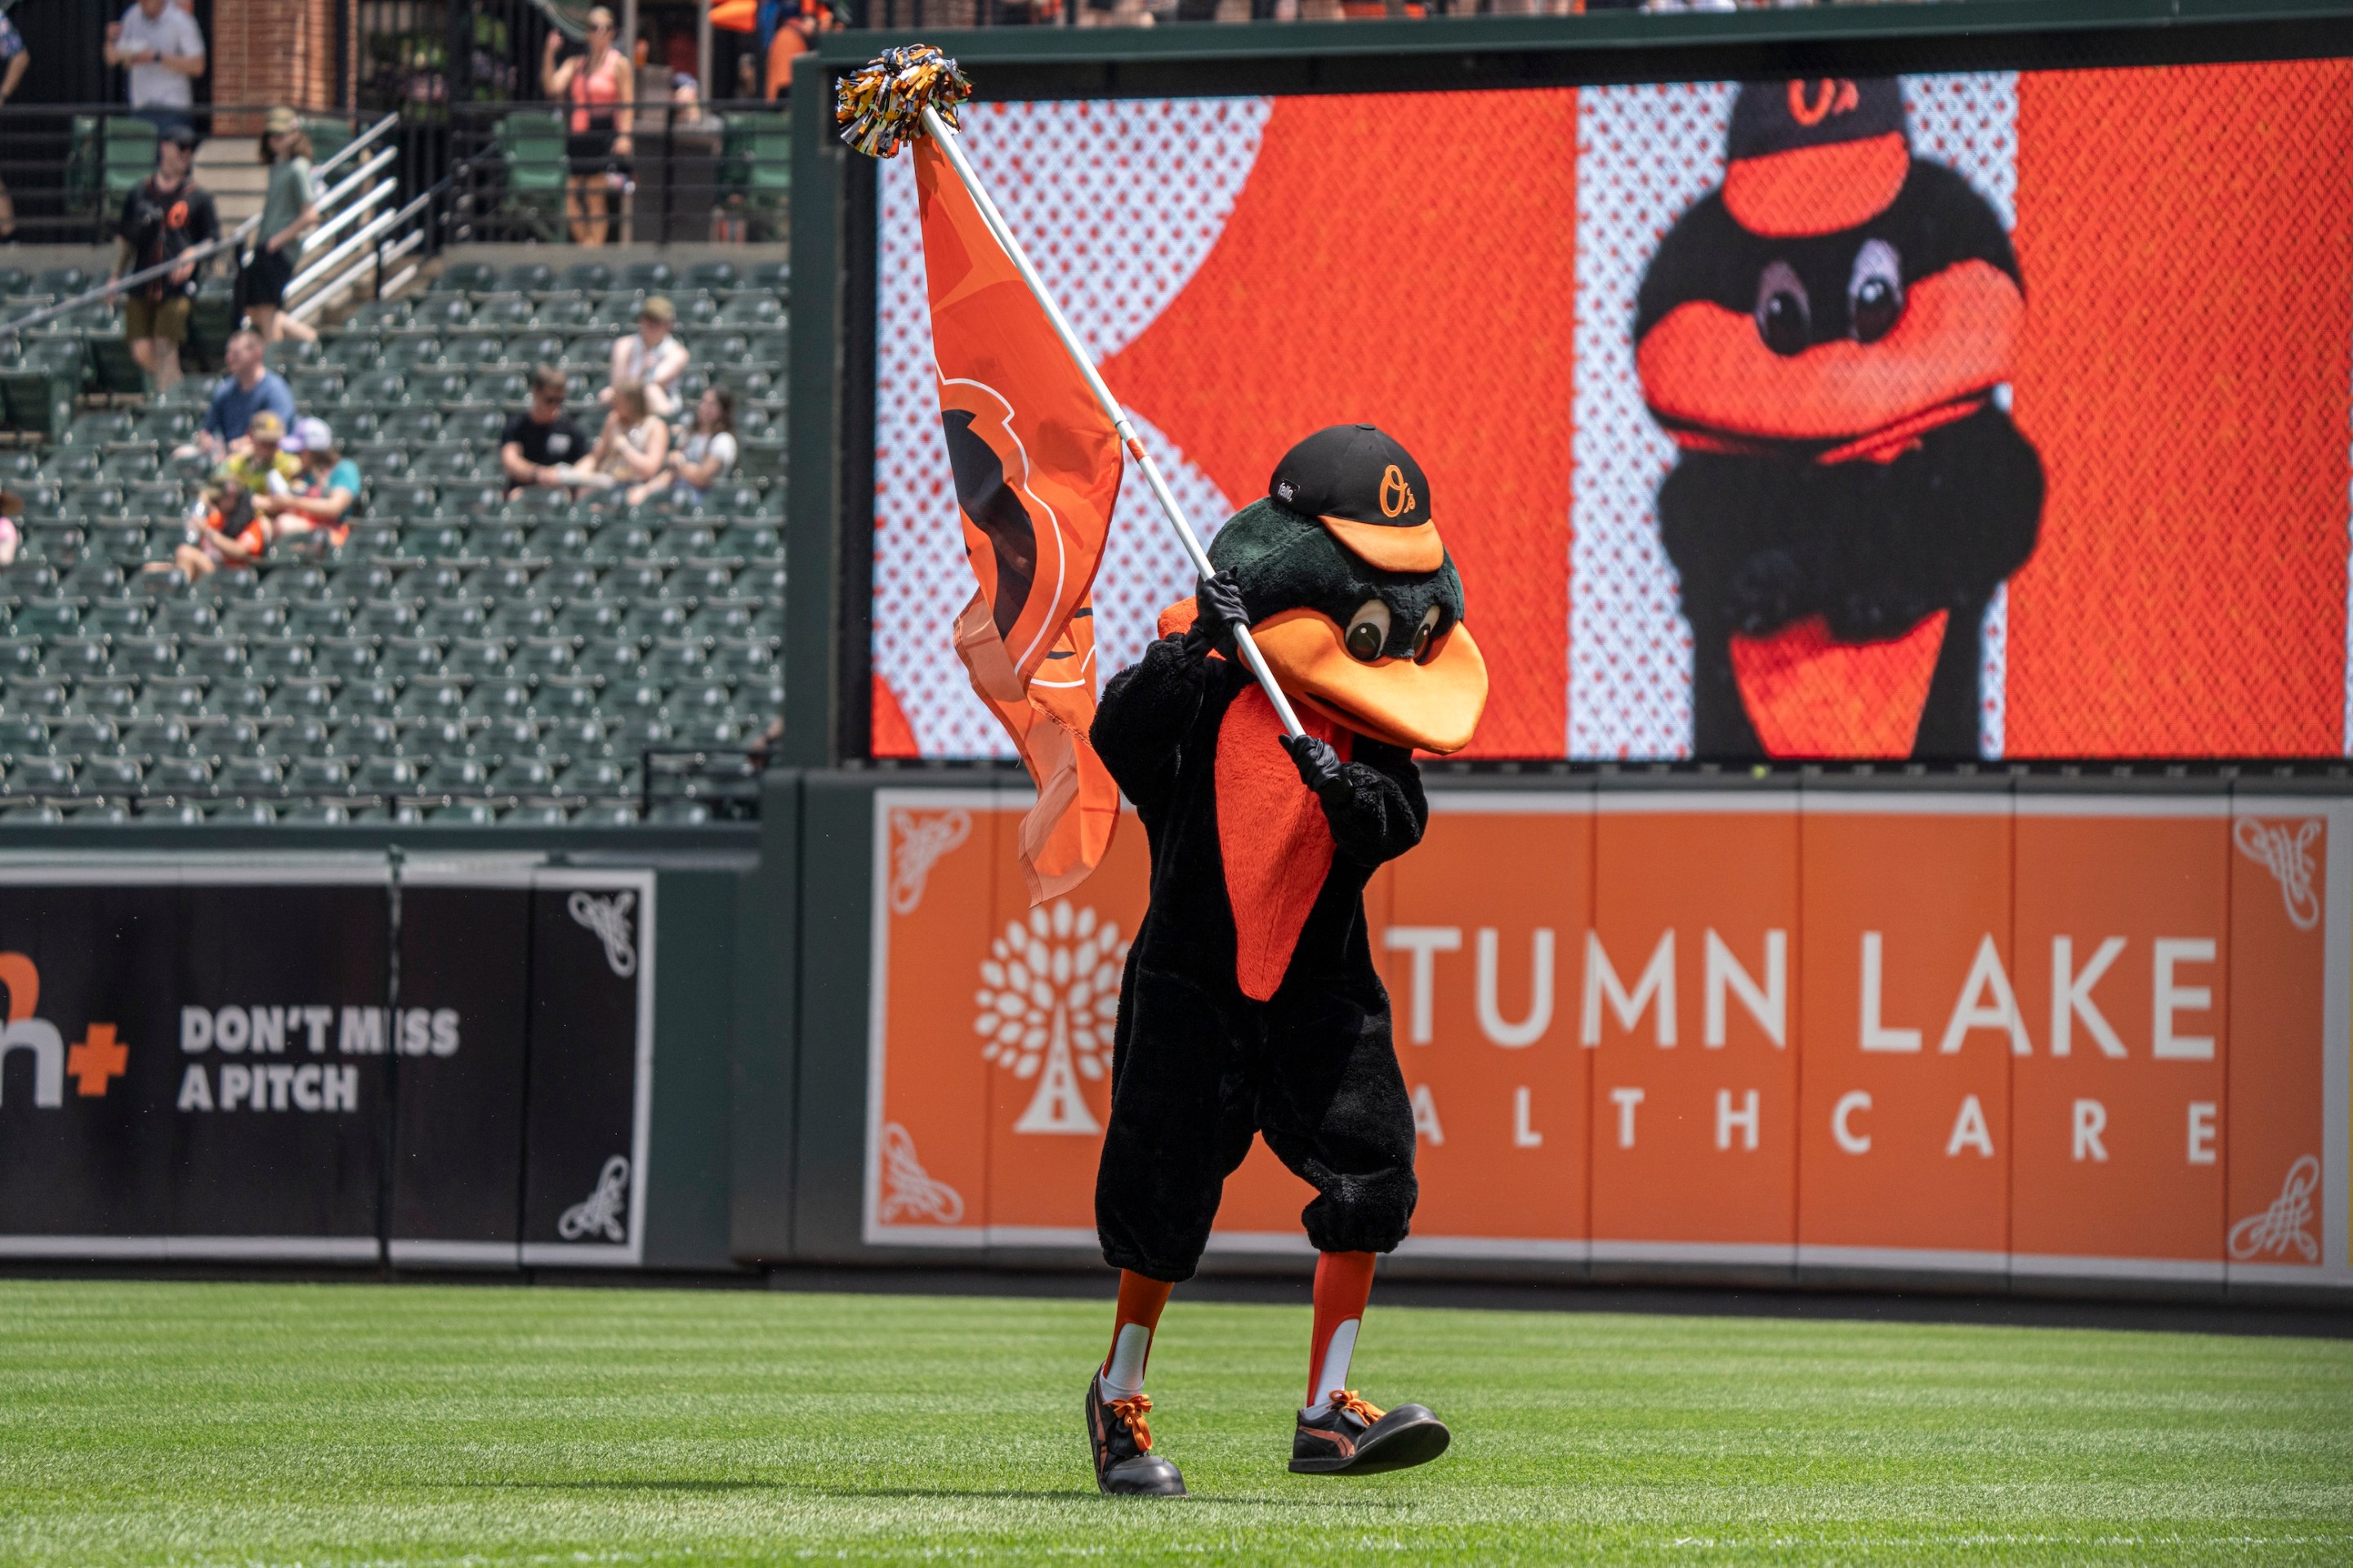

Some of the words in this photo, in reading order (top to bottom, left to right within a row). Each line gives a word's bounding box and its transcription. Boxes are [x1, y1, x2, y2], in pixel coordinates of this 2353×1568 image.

[1379, 464, 1416, 517] O's
[1383, 926, 1788, 1050] TUMN
[1860, 930, 2217, 1060] LAKE
[181, 1005, 333, 1054] DON'T
[338, 1006, 461, 1057] MISS
[176, 1064, 214, 1112] A
[220, 1064, 359, 1112] PITCH
[1413, 1084, 2217, 1164] ALTHCARE
